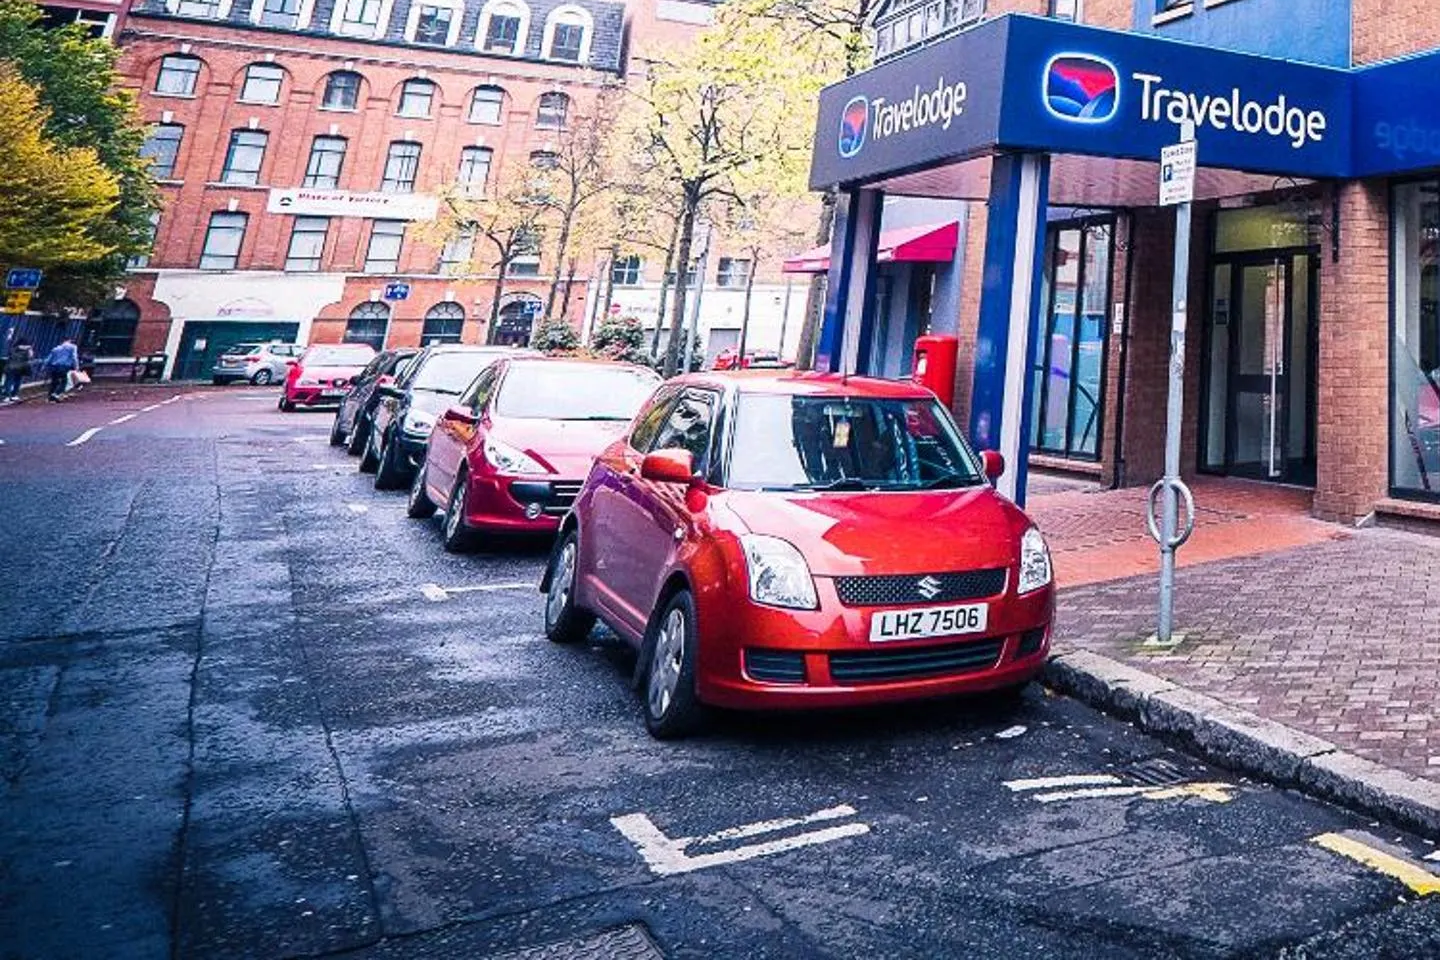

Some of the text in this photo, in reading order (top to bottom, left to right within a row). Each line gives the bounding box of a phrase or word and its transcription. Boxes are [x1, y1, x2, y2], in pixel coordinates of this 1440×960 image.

[871, 75, 967, 140] Travelodge
[1132, 73, 1326, 149] Travelodge
[880, 607, 979, 636] LHZ 7506
